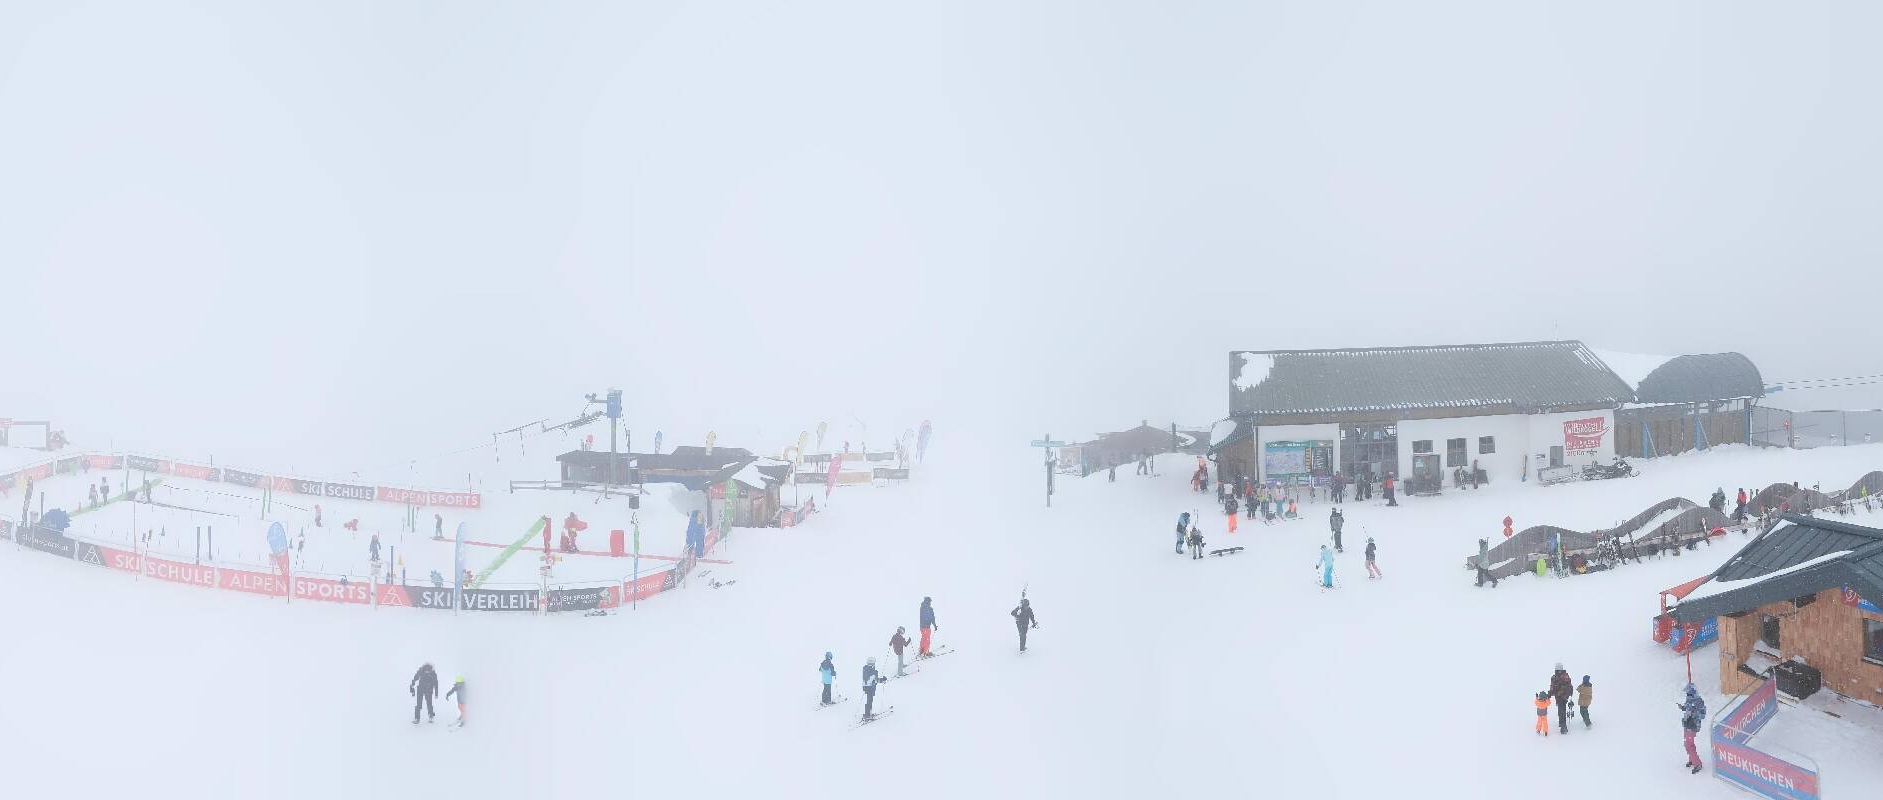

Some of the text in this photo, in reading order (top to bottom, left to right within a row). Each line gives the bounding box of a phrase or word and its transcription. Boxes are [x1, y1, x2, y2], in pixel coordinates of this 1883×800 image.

[301, 481, 372, 501] SKI SCHULE
[386, 489, 478, 506] ALPEN SPORTS
[115, 554, 213, 586] SKI SCHULE
[229, 576, 367, 600] ALPEN SPORTS
[421, 591, 452, 606] SKI
[463, 592, 538, 609] VERLEIH
[1718, 747, 1794, 791] NEUKIRCHEN
